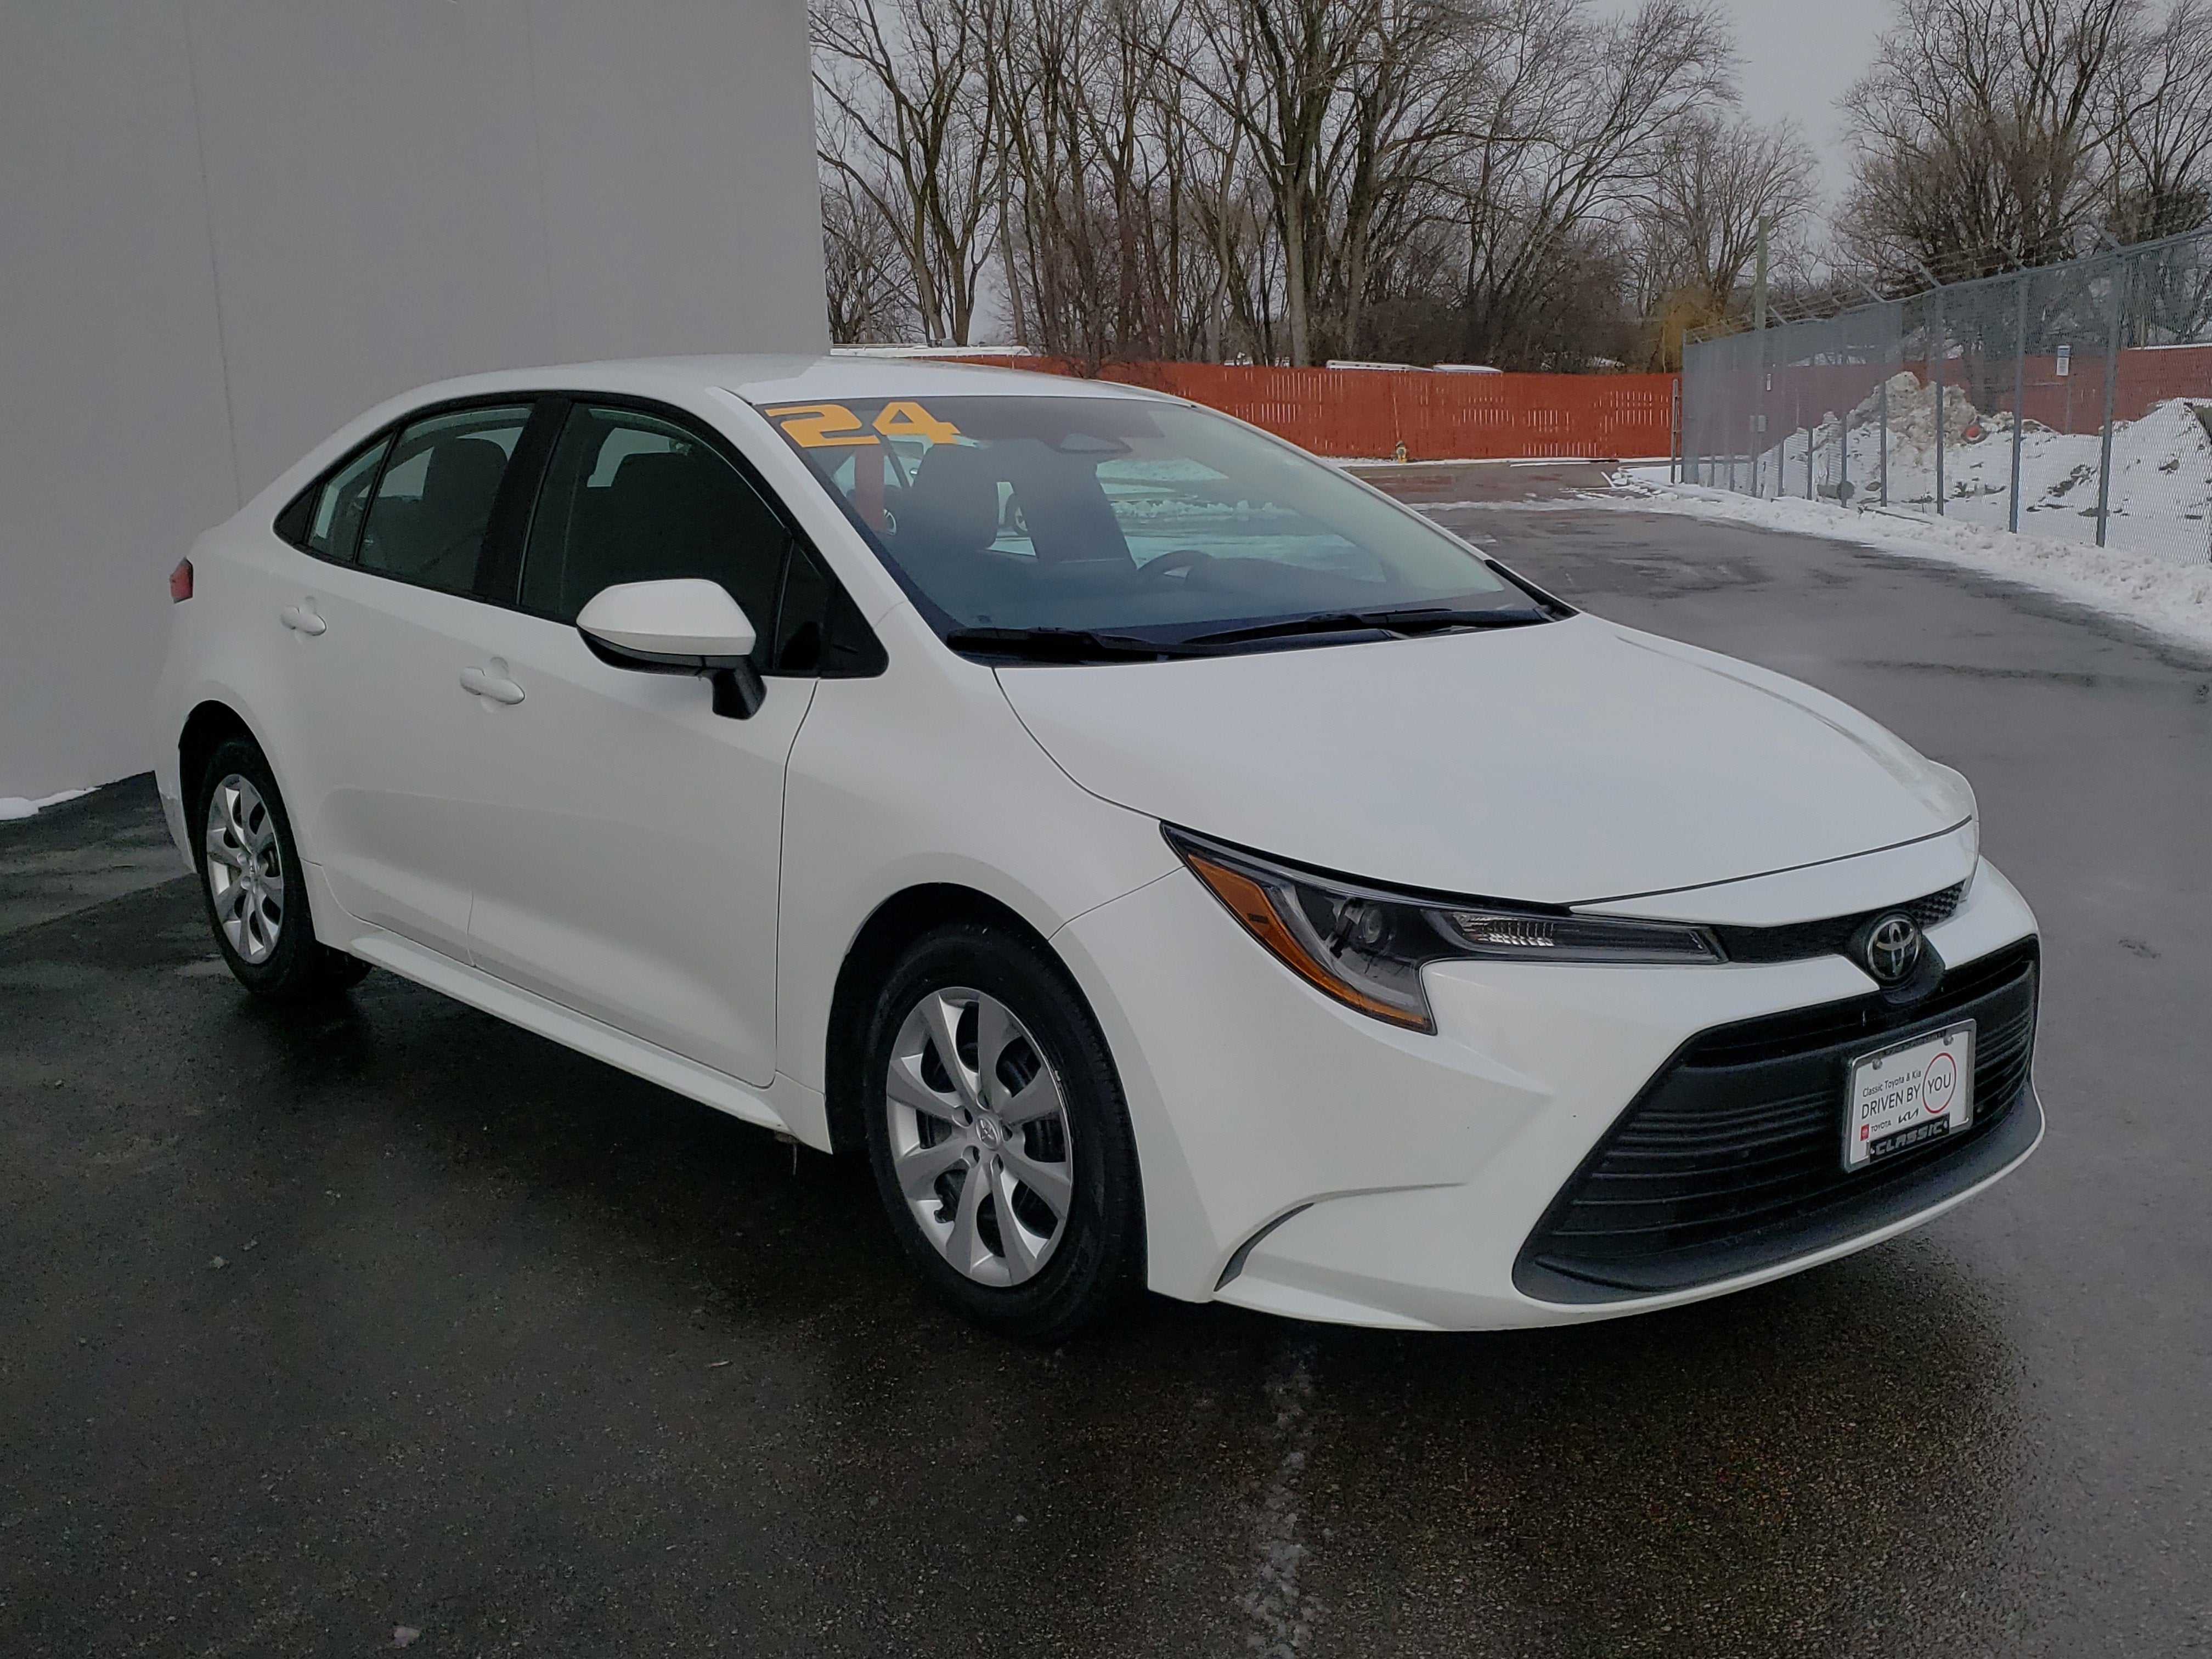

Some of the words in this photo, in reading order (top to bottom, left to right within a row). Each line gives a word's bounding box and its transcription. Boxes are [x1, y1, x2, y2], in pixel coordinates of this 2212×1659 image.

[764, 402, 961, 448] 24
[1861, 1090, 1904, 1120] DRIVEN
[1906, 1083, 1921, 1103] BY
[1927, 1073, 1951, 1094] YOU
[1862, 1083, 1883, 1098] Classic
[1884, 1076, 1905, 1090] Toyota
[1906, 1072, 1911, 1082] &
[1912, 1069, 1921, 1080] Kia
[1871, 1120, 1892, 1133] TOYOTA
[1875, 1120, 1944, 1156] CLASSIC
